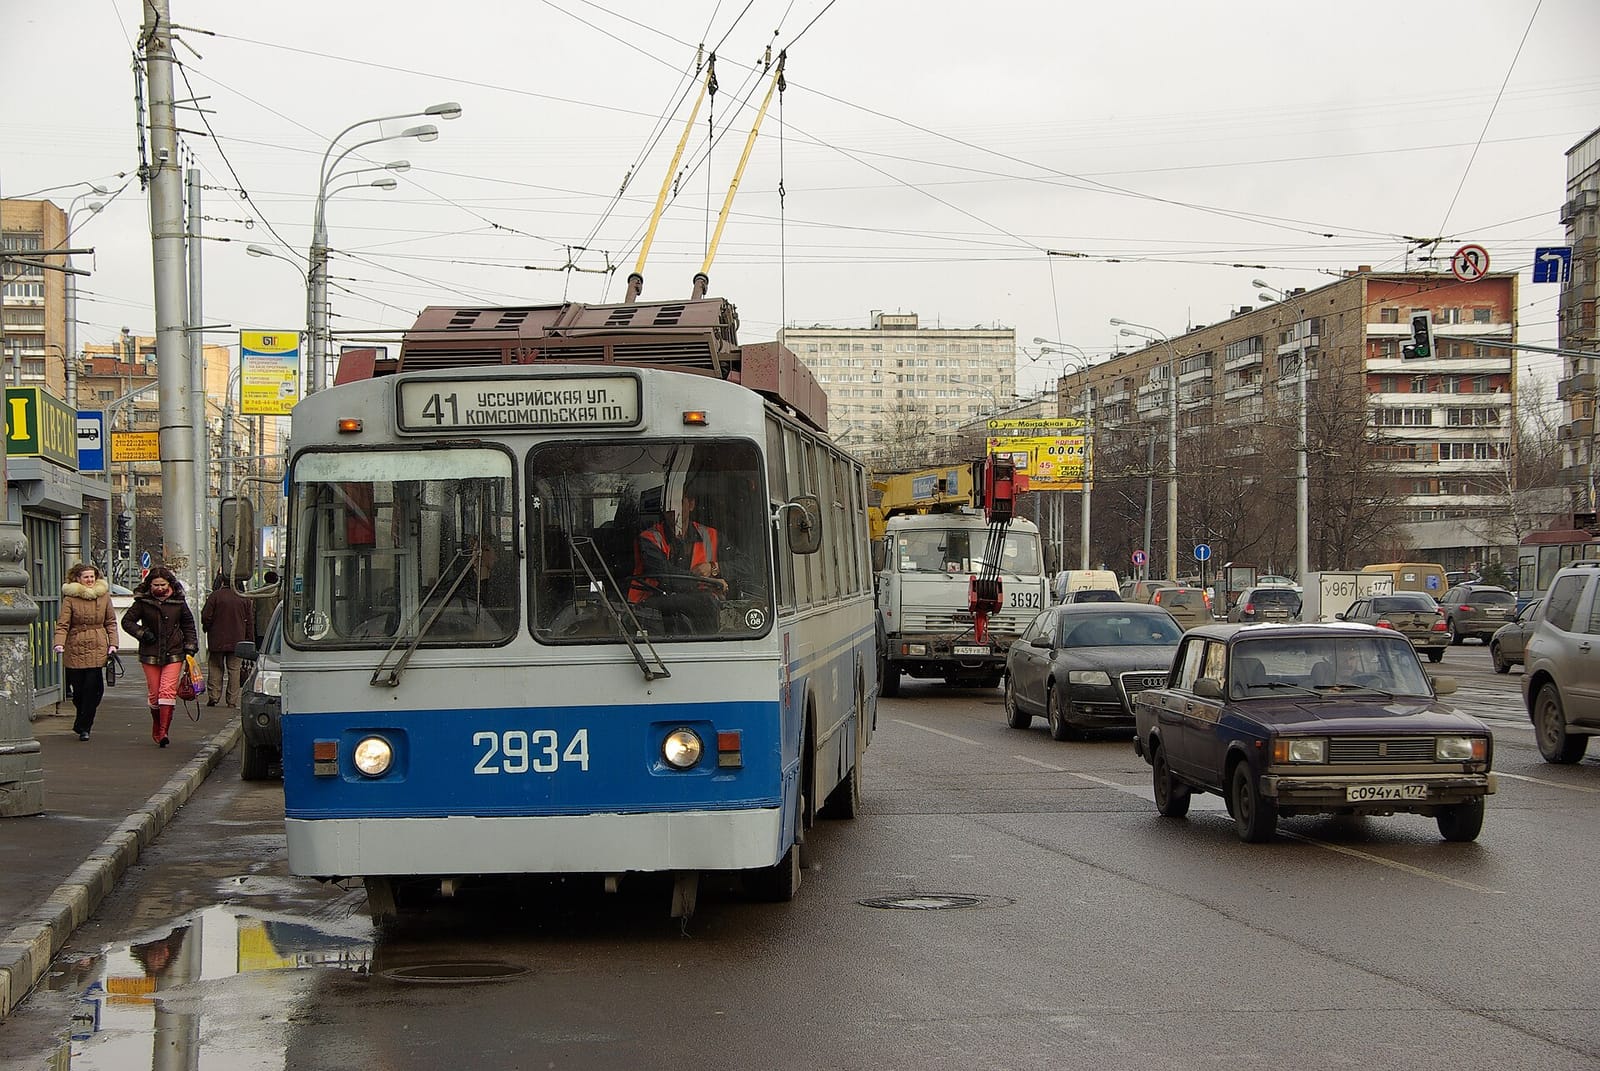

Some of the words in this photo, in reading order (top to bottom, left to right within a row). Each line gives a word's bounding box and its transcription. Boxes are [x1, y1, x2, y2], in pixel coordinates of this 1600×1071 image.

[422, 393, 459, 425] 41
[478, 390, 582, 407] УССУРИЙСКАЯ
[587, 389, 615, 404] УЛ.
[466, 407, 597, 425] КОМСОМОЛЬСКАЯ
[602, 406, 629, 421] ПЛ.
[42, 400, 76, 459] ЦВЕТЫ
[1010, 592, 1039, 608] 3692
[473, 729, 590, 774] 2934
